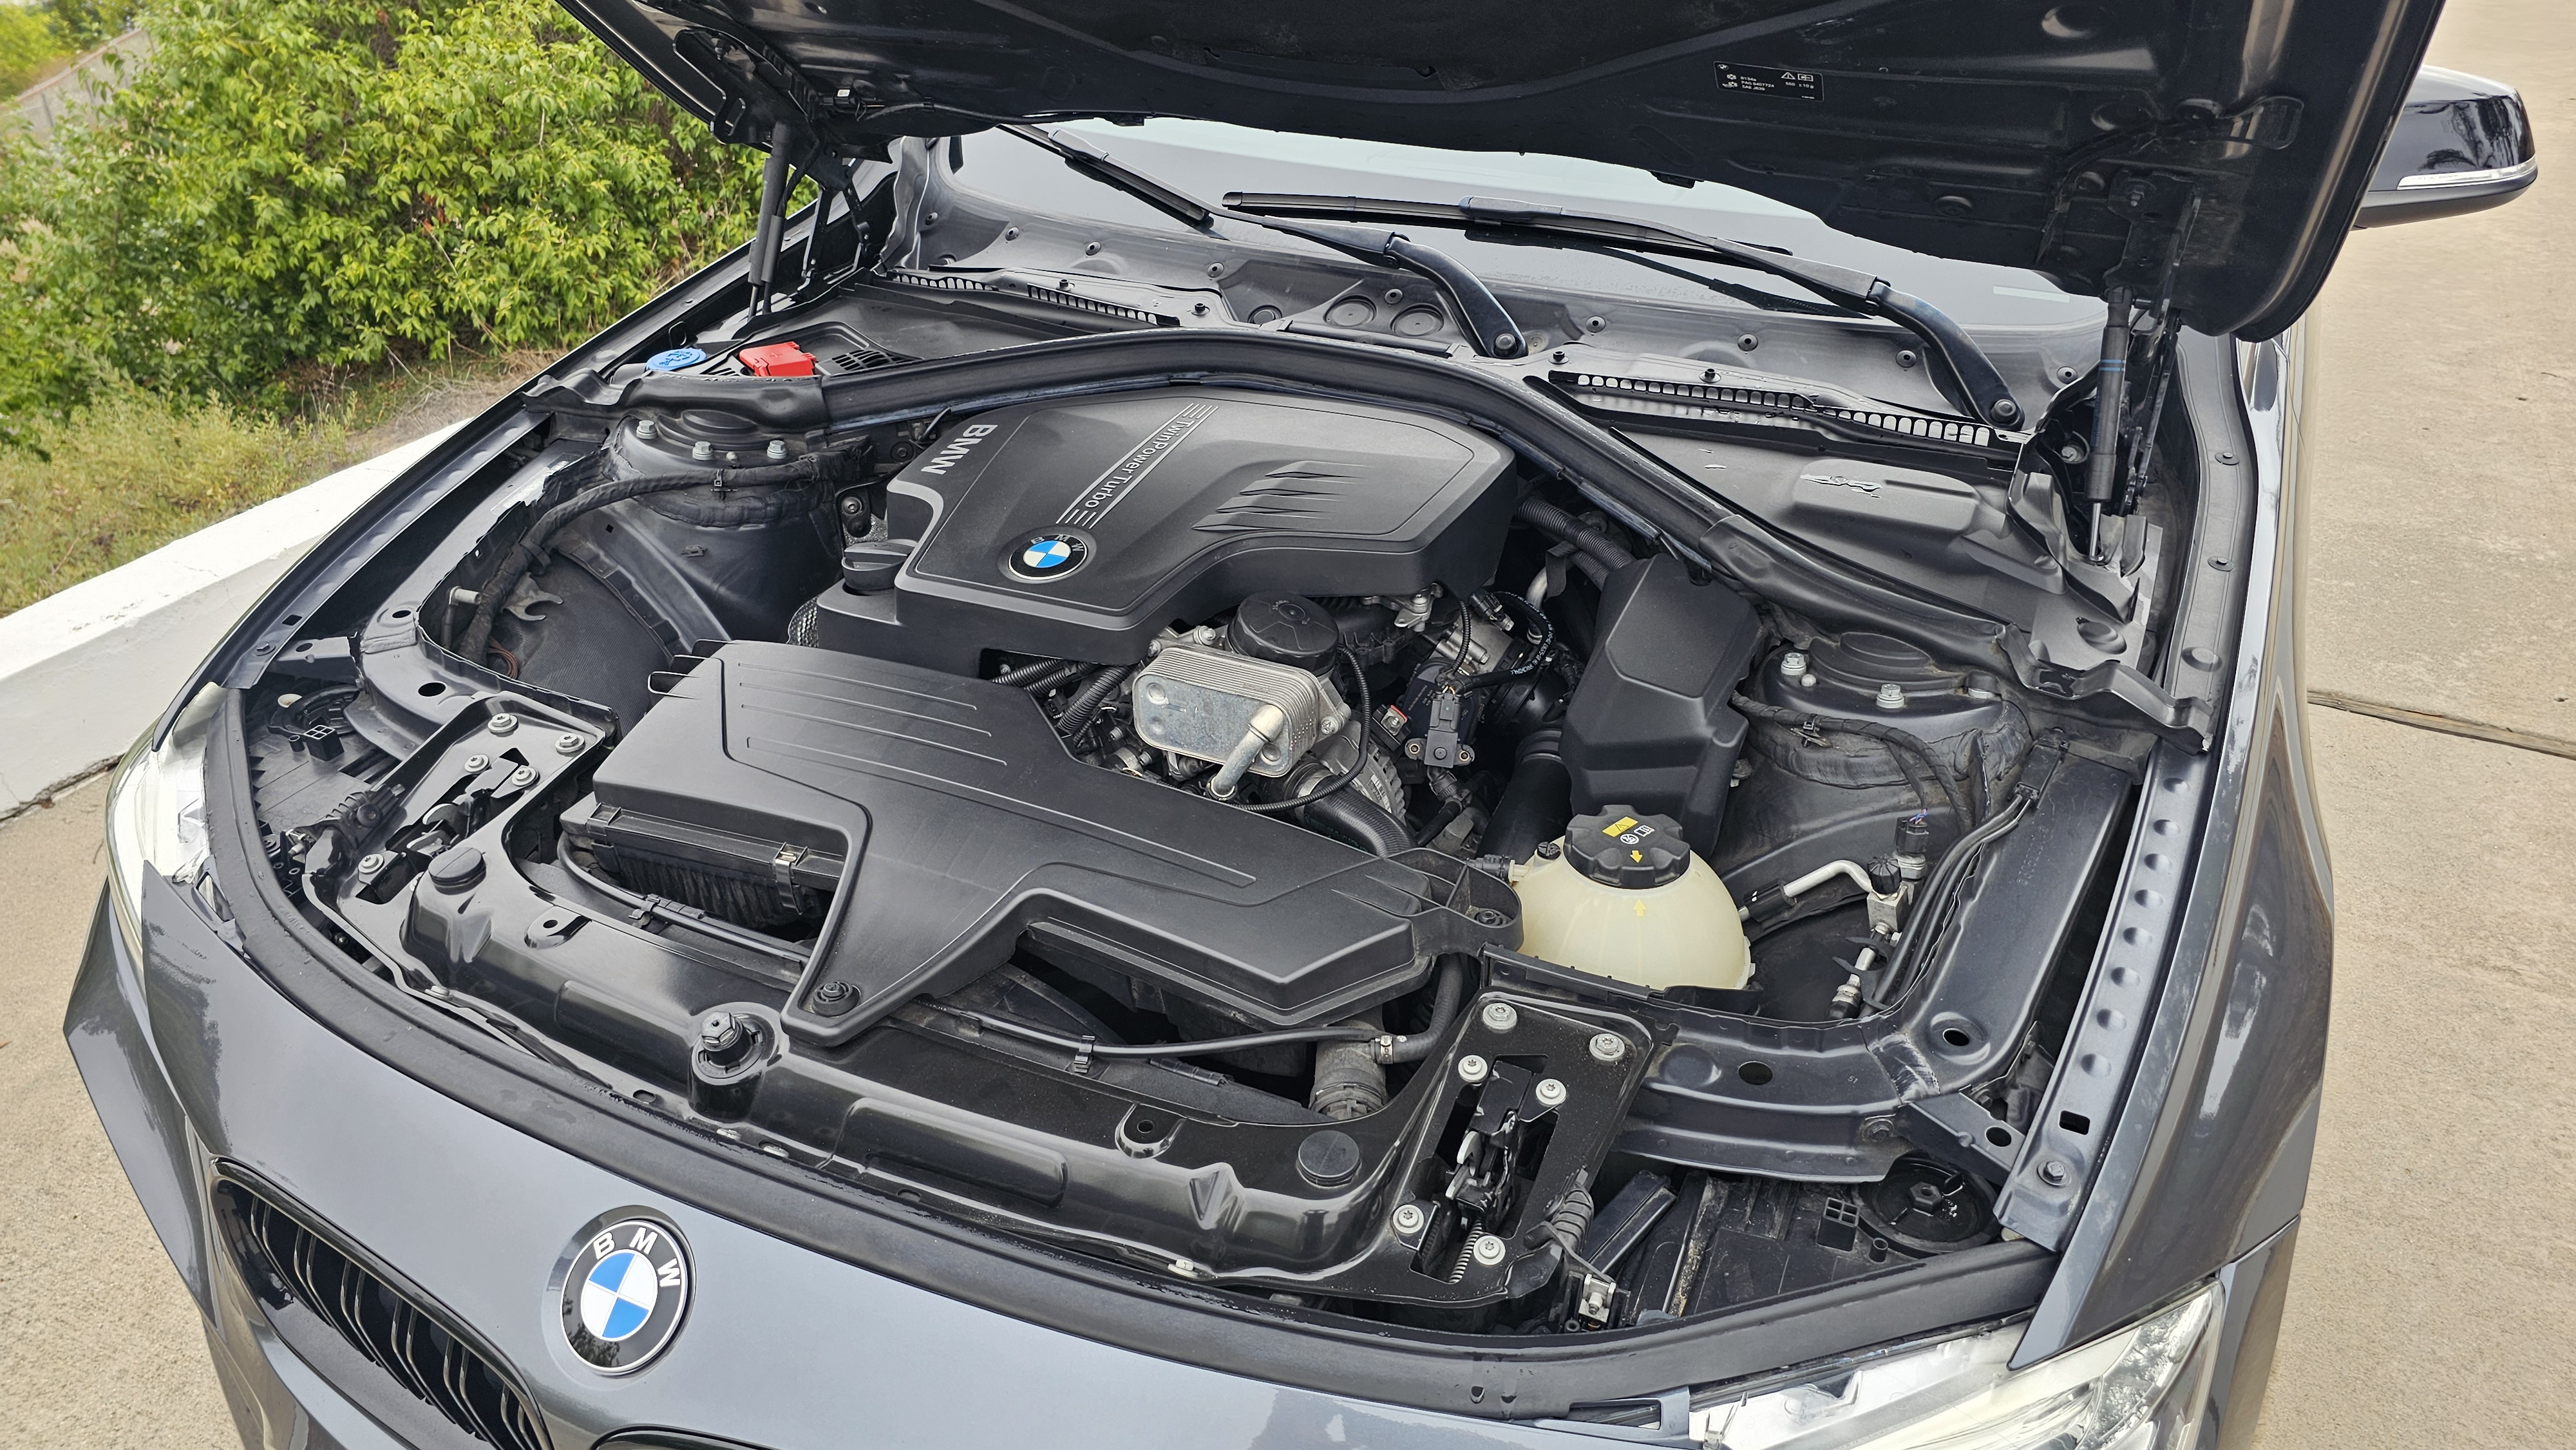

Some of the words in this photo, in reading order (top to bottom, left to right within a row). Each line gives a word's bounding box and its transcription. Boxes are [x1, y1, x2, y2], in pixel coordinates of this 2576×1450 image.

[921, 424, 998, 475] BMW
[1122, 420, 1195, 474] TwinPower
[1085, 475, 1133, 507] Turbo
[1030, 534, 1084, 551] BMW
[594, 1227, 681, 1288] BMW
